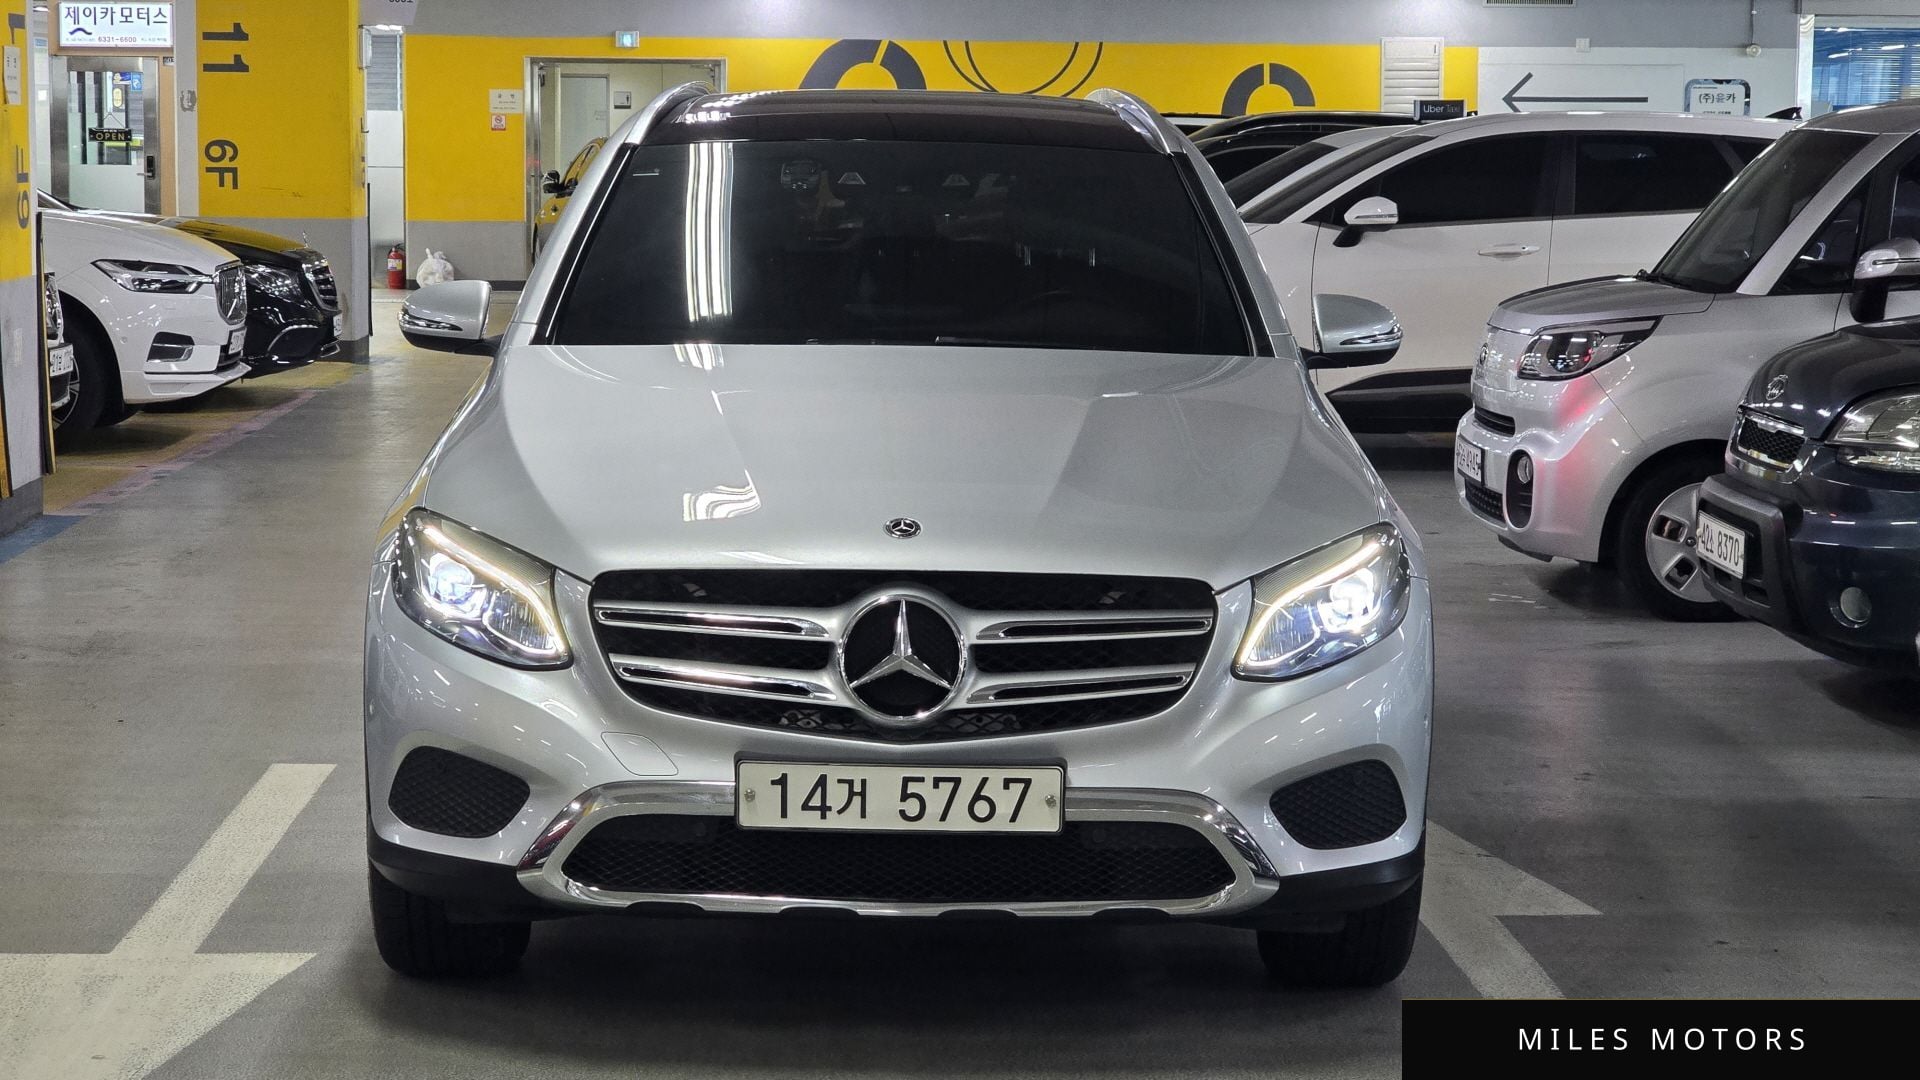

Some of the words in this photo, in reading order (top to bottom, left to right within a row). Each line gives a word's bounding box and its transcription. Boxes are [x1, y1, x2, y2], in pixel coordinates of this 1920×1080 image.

[202, 22, 249, 72] 11
[1423, 104, 1445, 113] Uber
[95, 132, 125, 141] OPEN
[204, 139, 239, 190] 6F
[1717, 530, 1740, 567] 8370
[770, 772, 867, 820] 14거
[899, 776, 1033, 823] 5767
